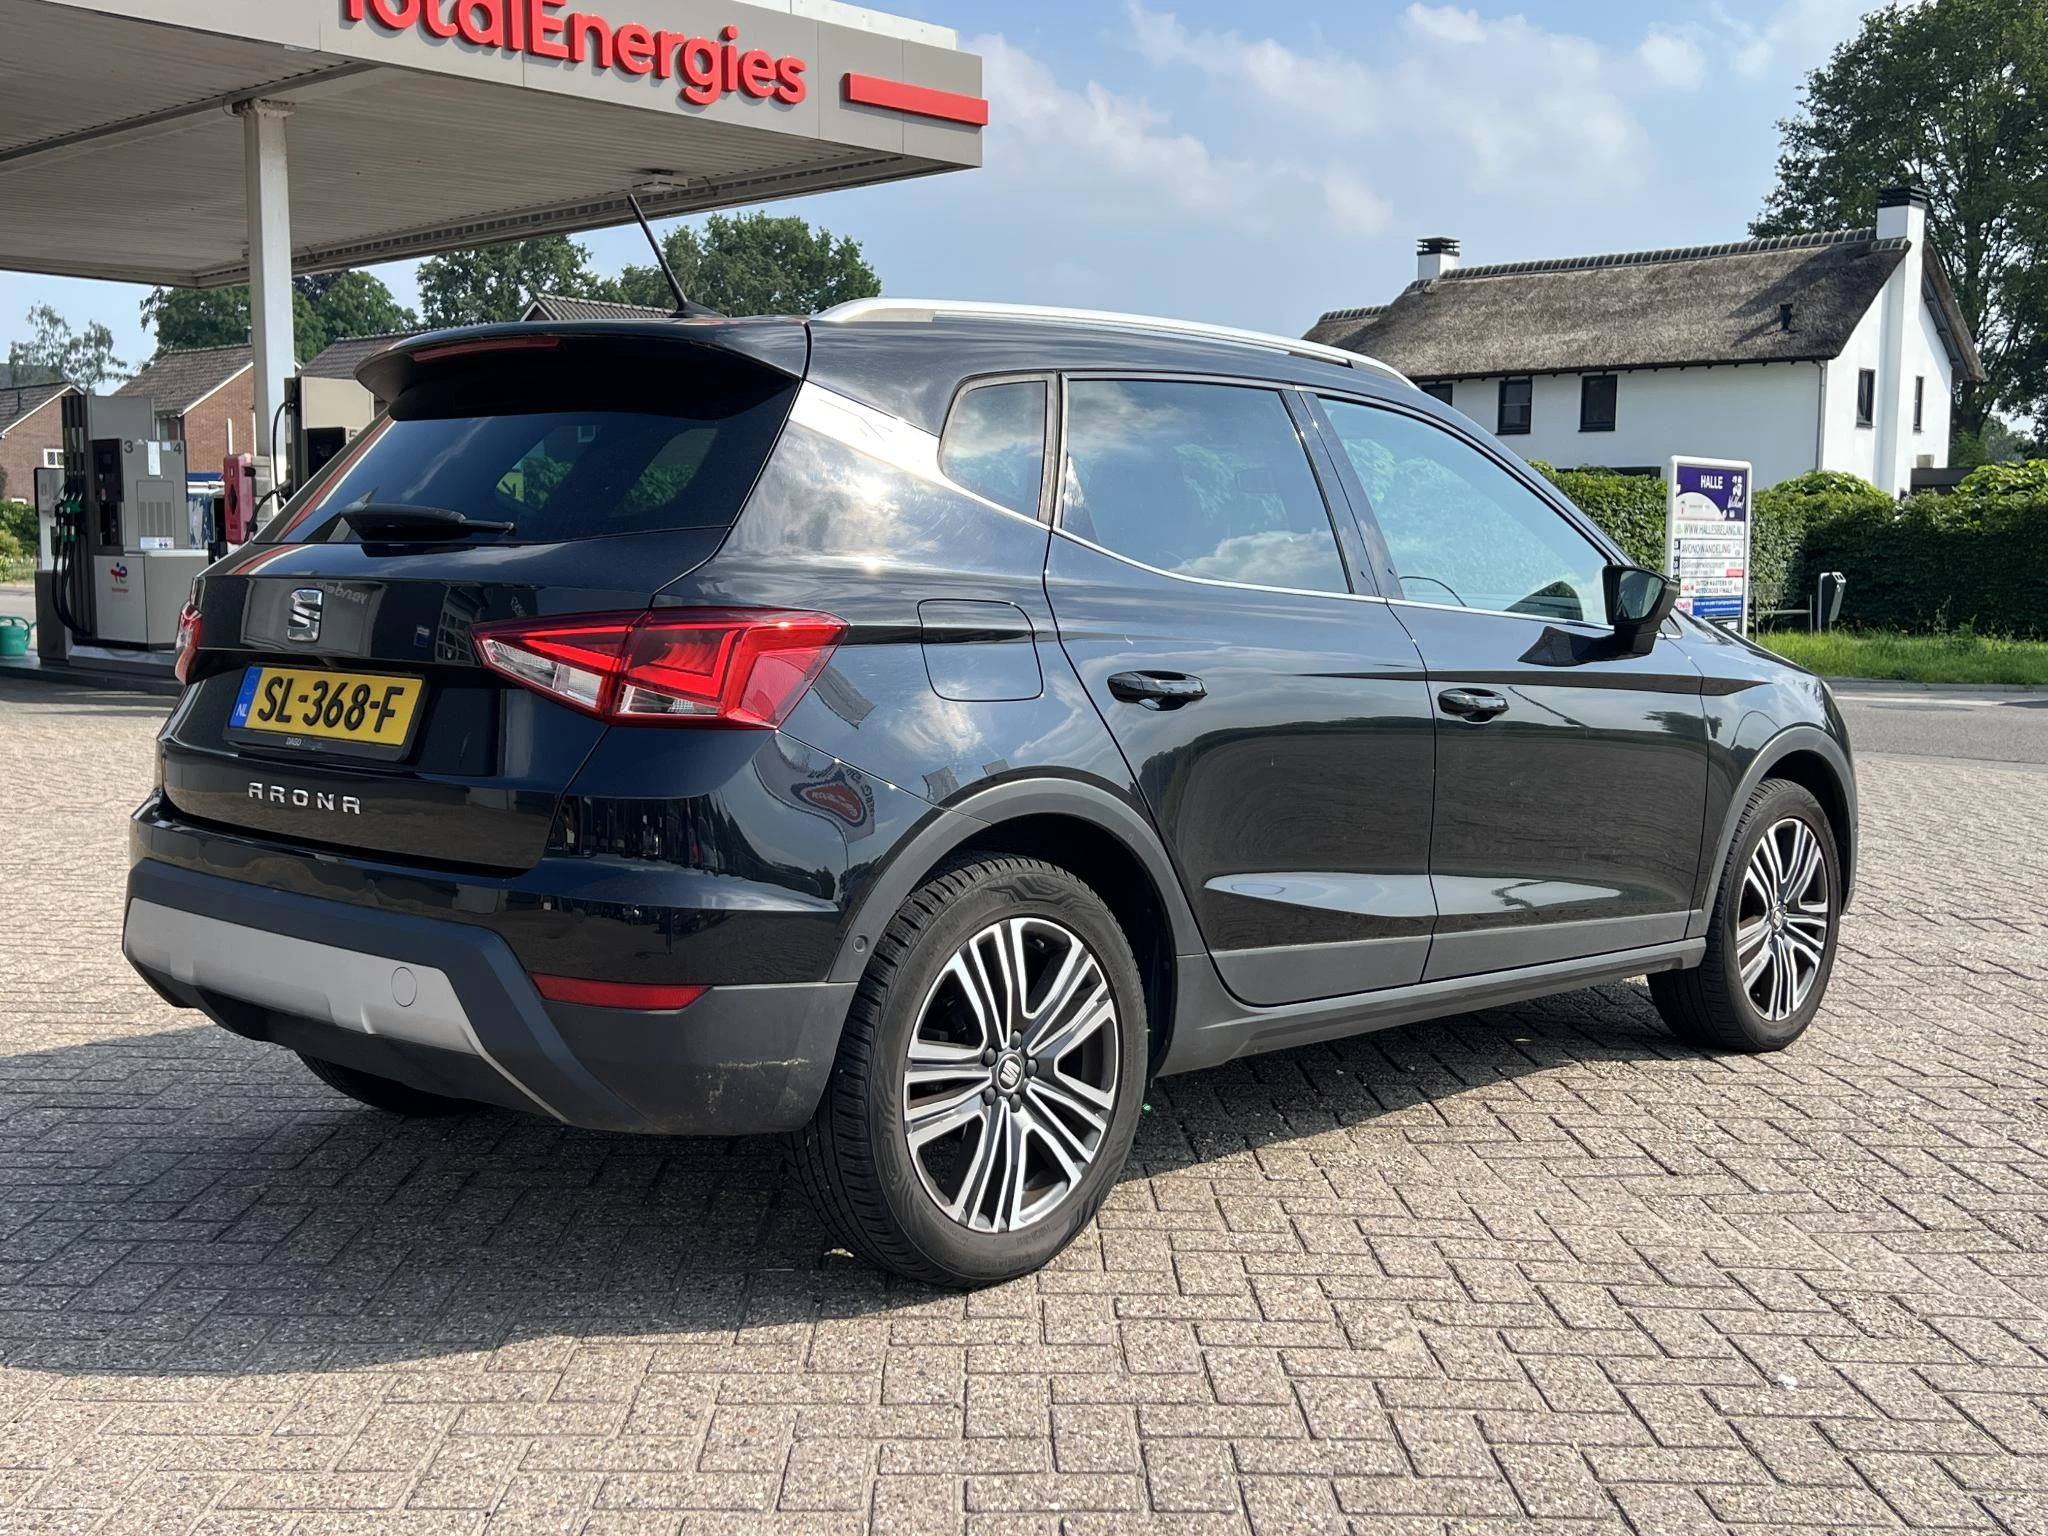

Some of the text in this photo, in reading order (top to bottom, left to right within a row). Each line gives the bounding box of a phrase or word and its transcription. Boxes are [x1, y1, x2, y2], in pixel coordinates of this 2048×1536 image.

[124, 440, 134, 454] 3
[173, 442, 183, 455] 4
[1700, 474, 1723, 490] HALLE
[235, 703, 248, 717] NL
[257, 676, 405, 733] SL-368-F
[248, 782, 361, 815] ARONA
